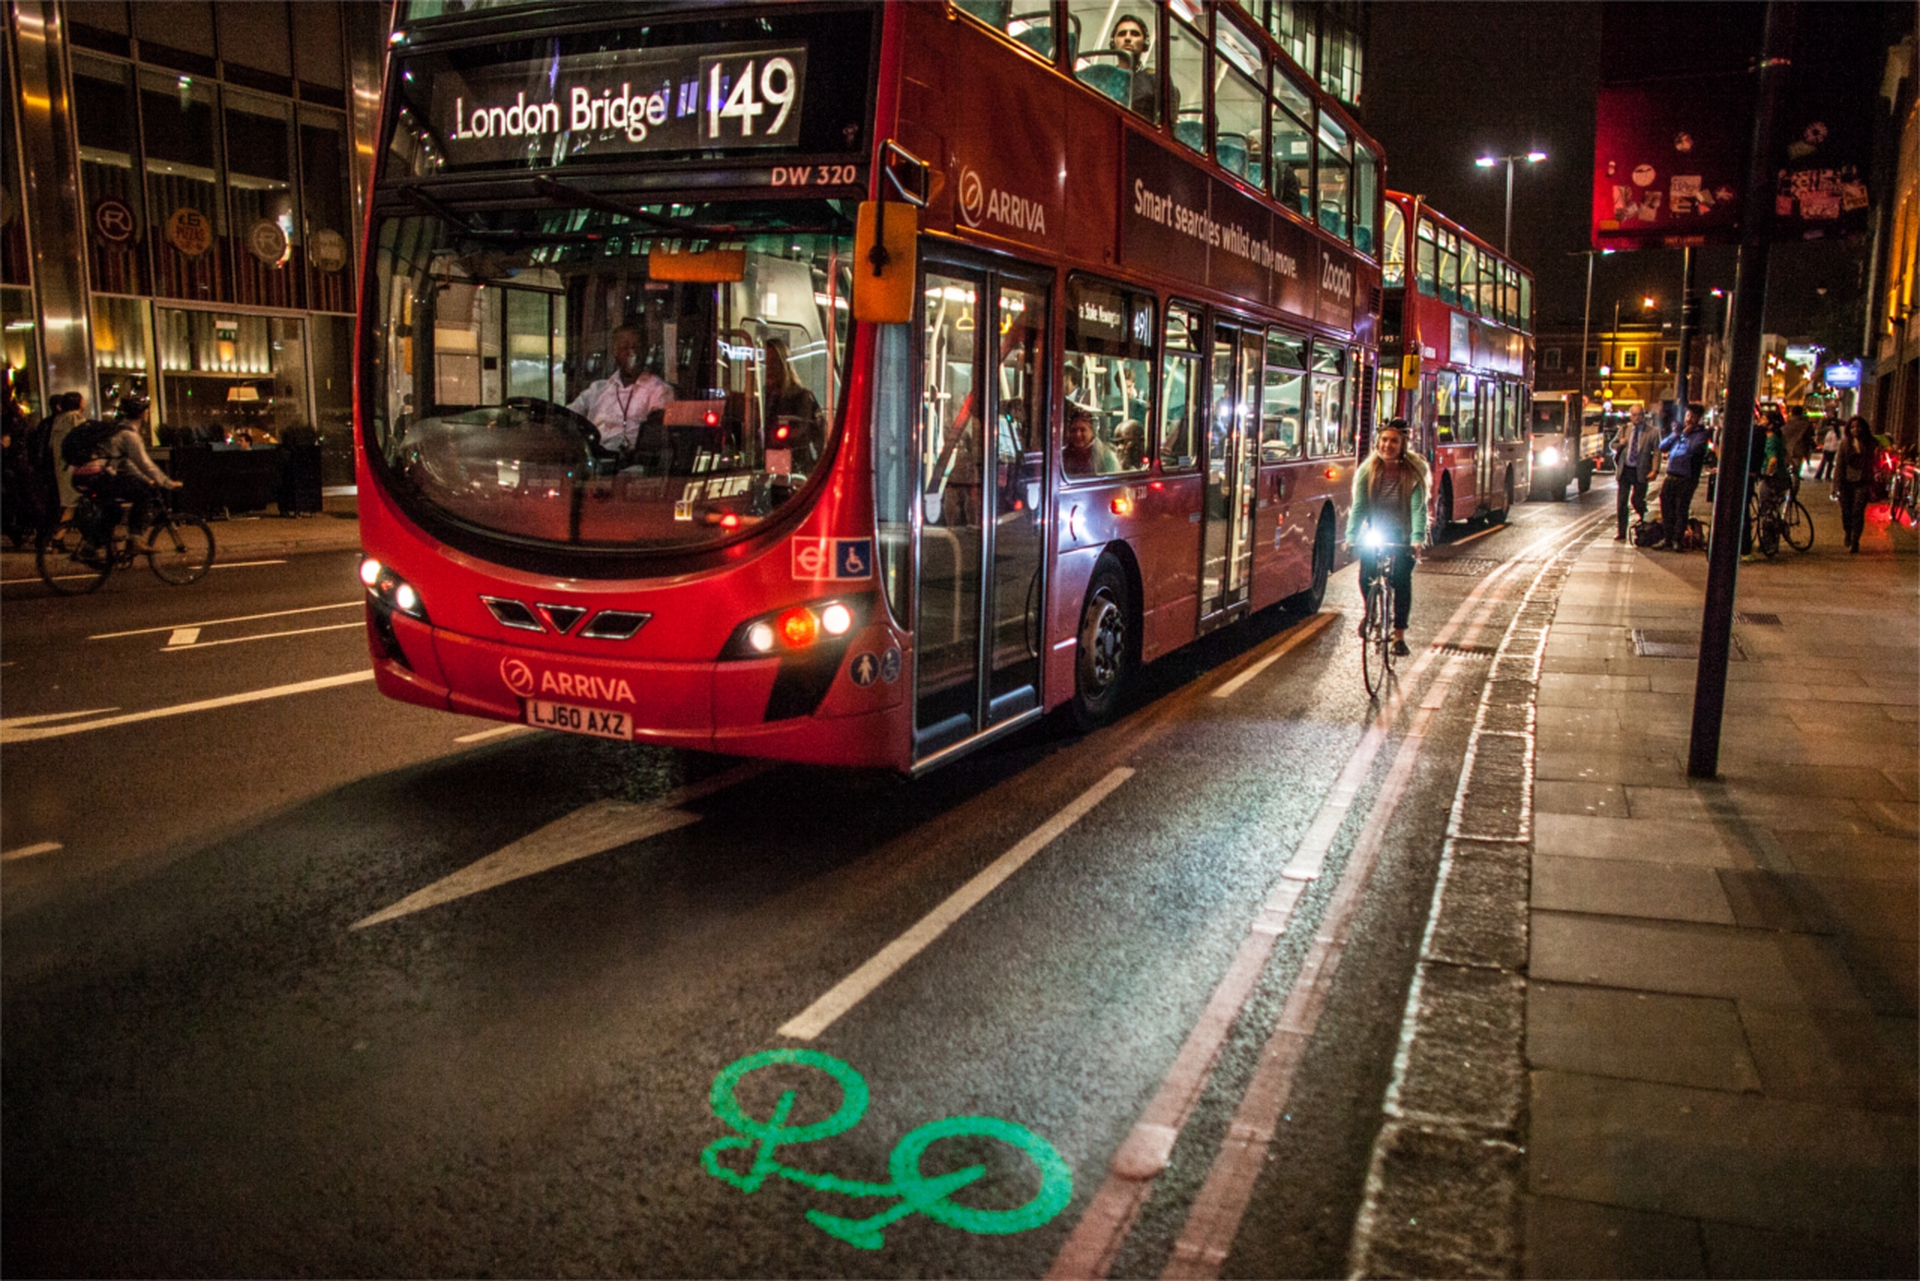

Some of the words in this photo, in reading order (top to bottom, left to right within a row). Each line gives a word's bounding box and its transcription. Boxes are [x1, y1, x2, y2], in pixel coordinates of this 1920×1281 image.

[457, 91, 559, 139] London
[570, 83, 667, 142] Bridge
[709, 57, 797, 139] 149
[771, 167, 810, 187] DW
[816, 165, 857, 185] 320
[986, 187, 1046, 236] ARRIVA
[1134, 178, 1173, 227] Smart
[1174, 203, 1220, 247] searches
[1221, 222, 1250, 259] whilst
[1250, 240, 1261, 263] on
[1261, 239, 1274, 269] the
[1274, 251, 1298, 279] move.
[1322, 251, 1352, 302] Zoopla
[541, 670, 637, 704] ARRIVA
[533, 703, 581, 731] LJ60
[586, 710, 625, 736] AXZ
